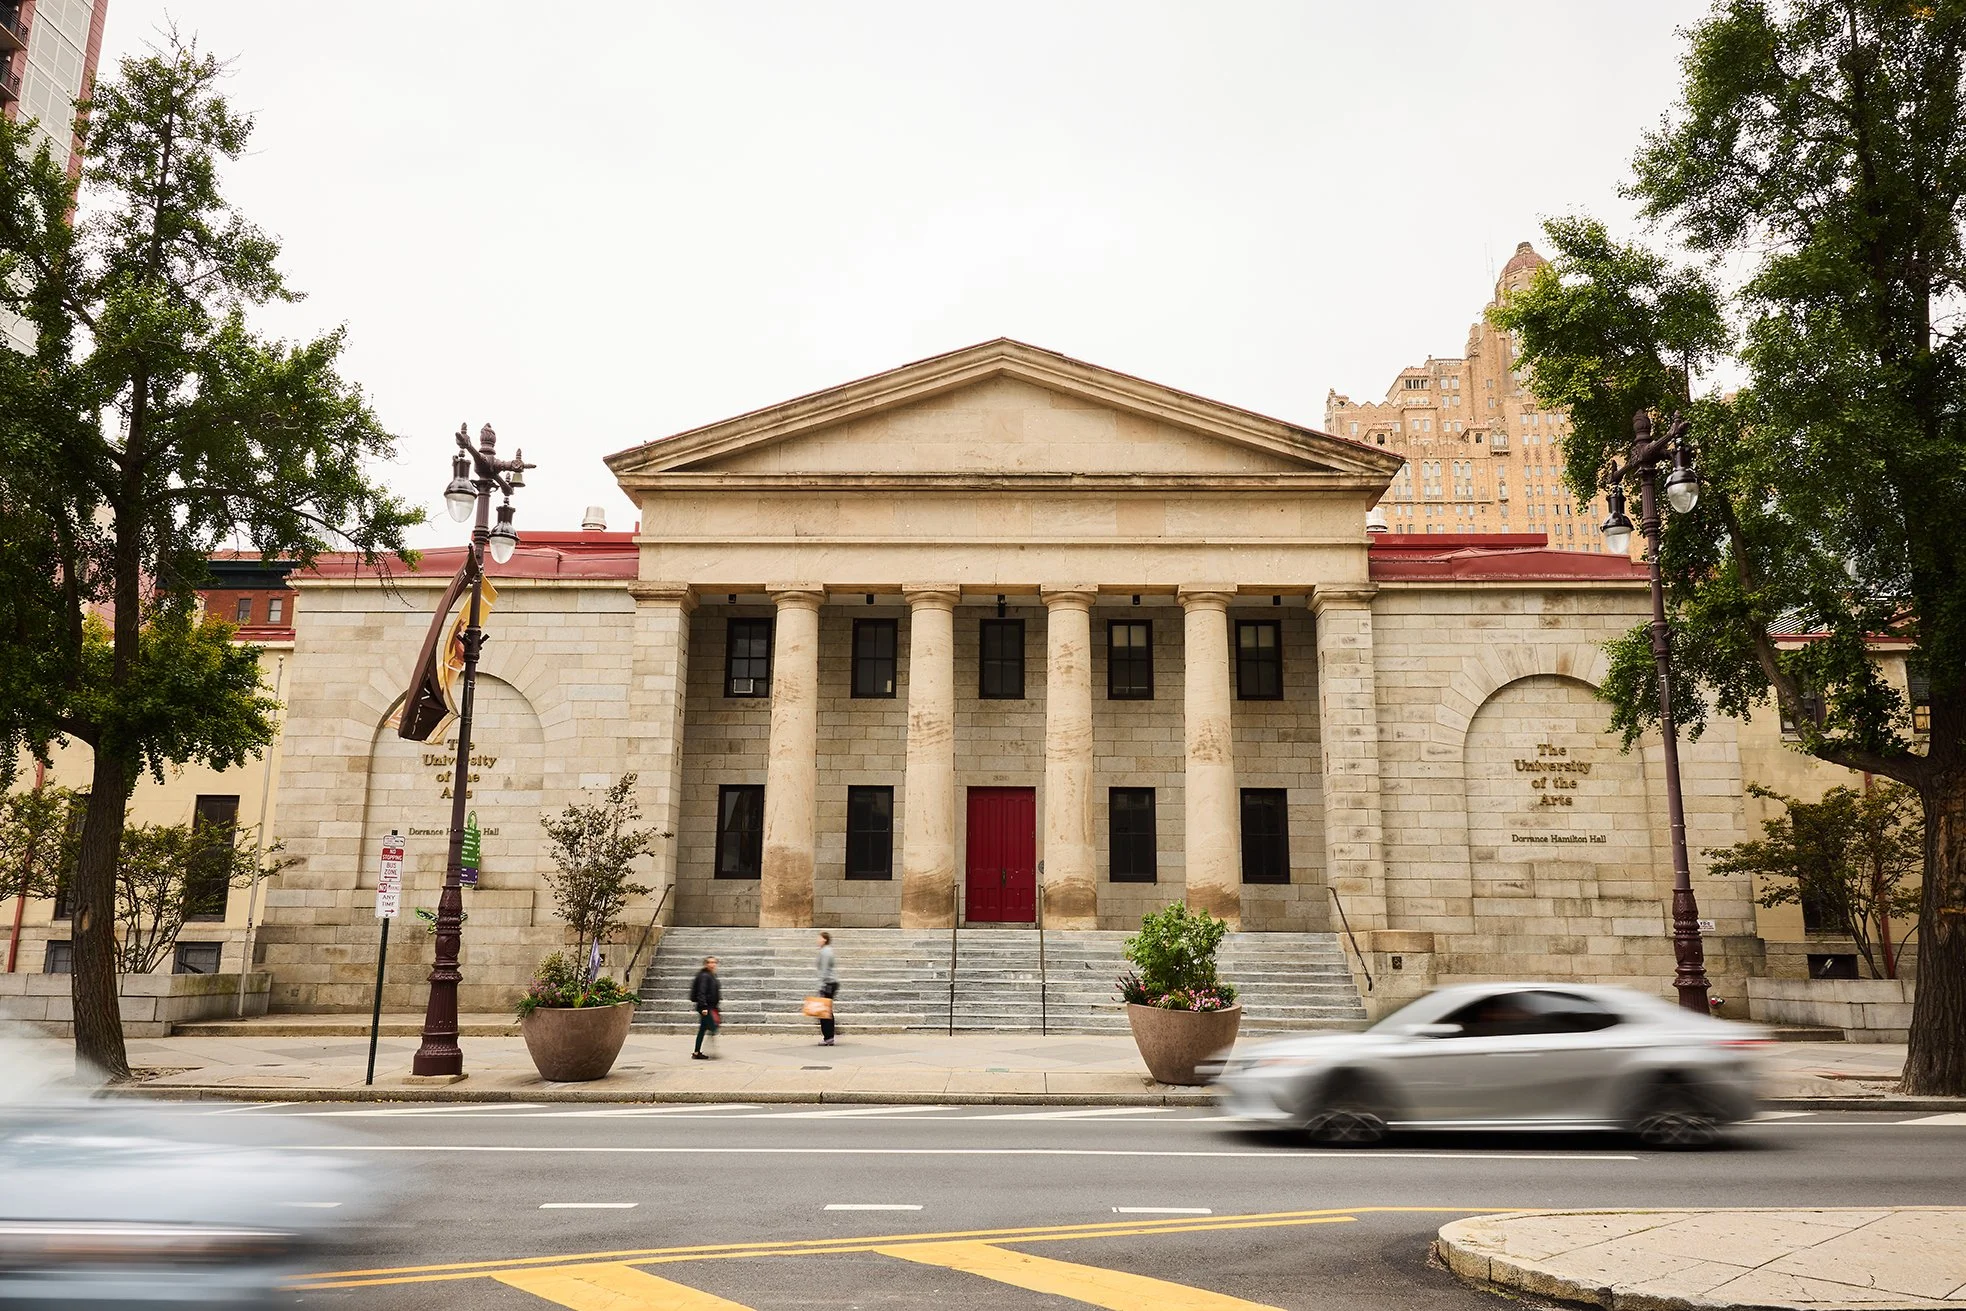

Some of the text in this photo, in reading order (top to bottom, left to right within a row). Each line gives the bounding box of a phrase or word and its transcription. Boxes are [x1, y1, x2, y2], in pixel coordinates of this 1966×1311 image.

[447, 739, 475, 750] Te
[1537, 743, 1567, 756] The
[423, 754, 497, 768] Univsity
[1514, 760, 1592, 774] University
[436, 771, 452, 782] of
[1531, 777, 1577, 789] of the
[441, 787, 473, 799] As
[1539, 794, 1573, 806] Arts
[408, 828, 443, 836] Dorrance
[483, 828, 499, 836] Hall
[1511, 834, 1607, 843] Dorrance Hamilton Hall
